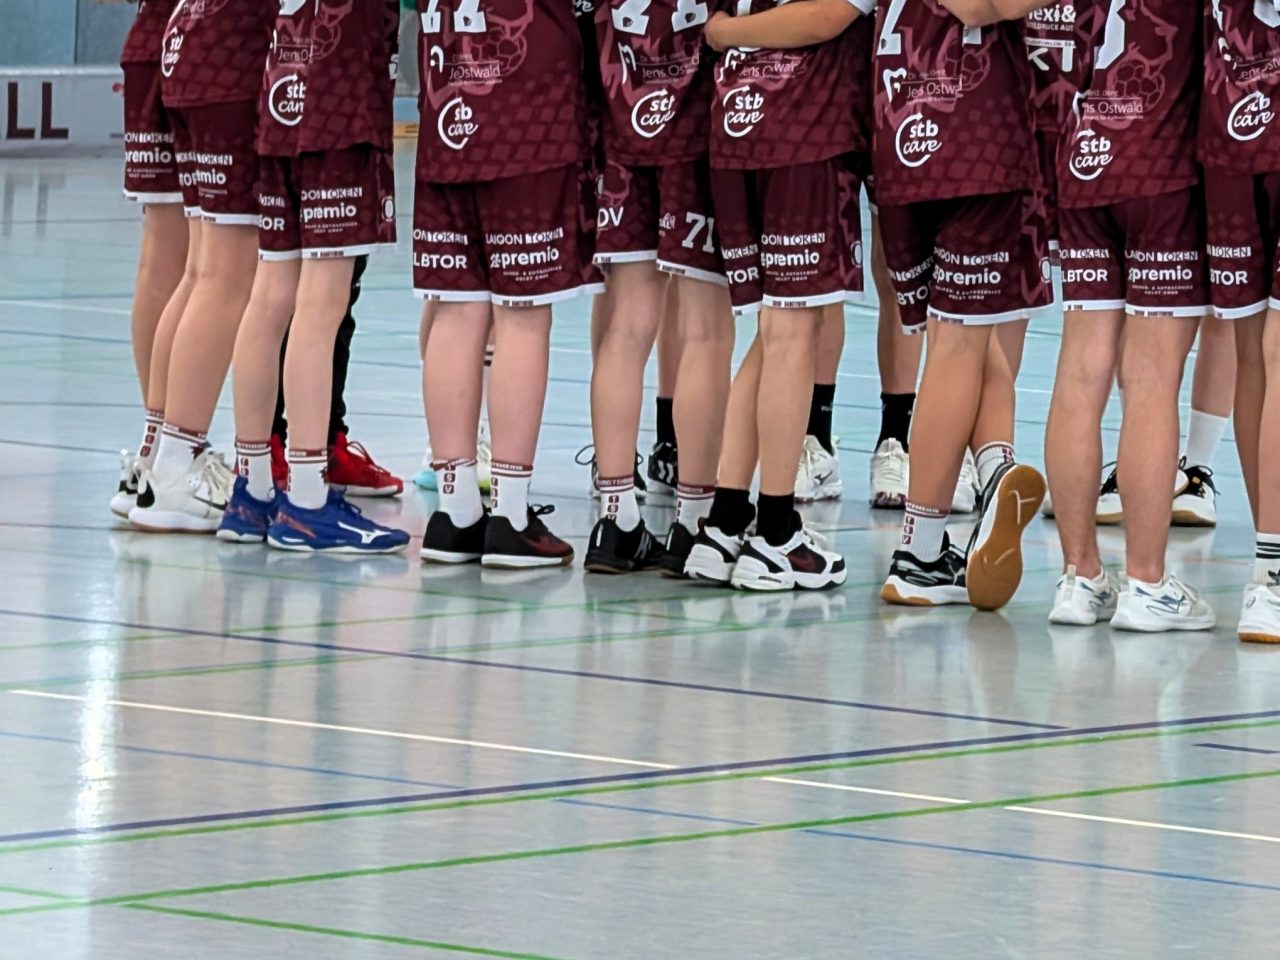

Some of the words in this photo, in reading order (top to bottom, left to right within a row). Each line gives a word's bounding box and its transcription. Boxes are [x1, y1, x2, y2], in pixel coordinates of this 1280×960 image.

[735, 93, 764, 111] stb
[1098, 96, 1142, 109] Ostwald
[728, 110, 764, 125] care
[1234, 111, 1275, 128] care
[909, 119, 939, 139] stb
[903, 139, 942, 155] care
[1080, 137, 1110, 154] stb
[1075, 154, 1113, 169] care
[304, 202, 357, 223] premio
[682, 211, 715, 254] 71
[502, 247, 559, 269] premio
[766, 249, 820, 268] premio
[1157, 250, 1198, 262] TOKEN
[938, 268, 1001, 286] premio
[1132, 265, 1193, 283] premio
